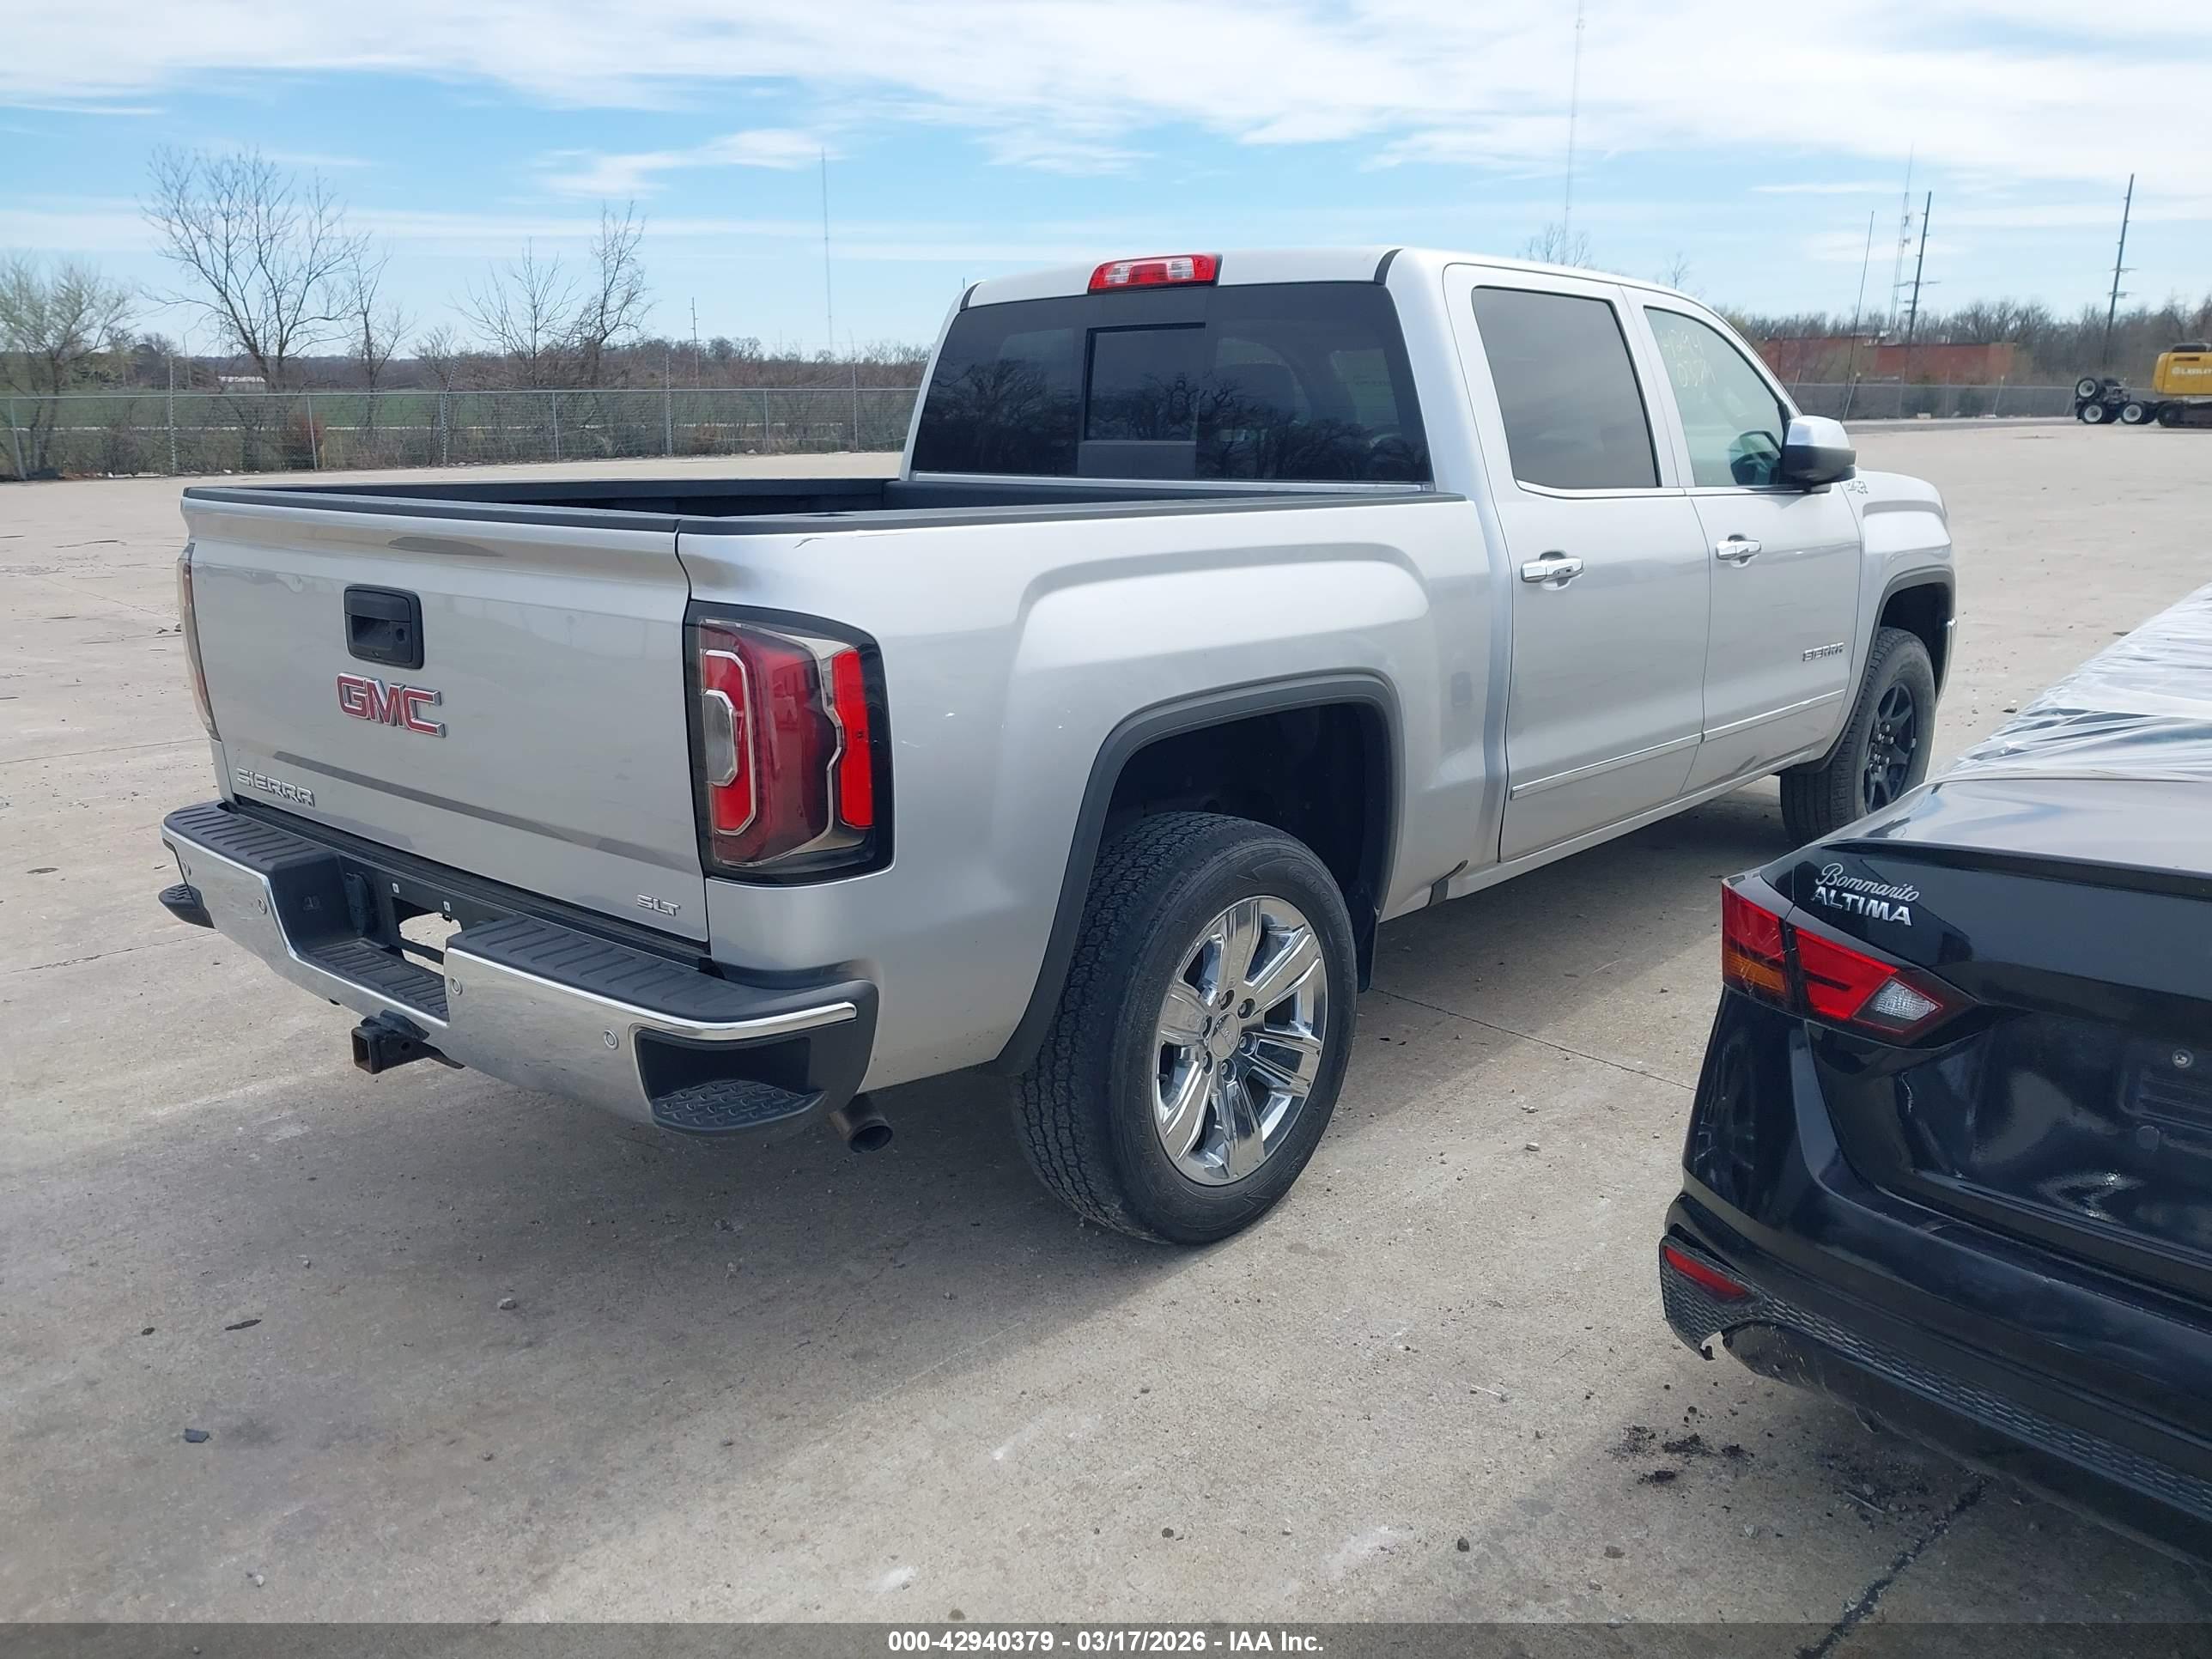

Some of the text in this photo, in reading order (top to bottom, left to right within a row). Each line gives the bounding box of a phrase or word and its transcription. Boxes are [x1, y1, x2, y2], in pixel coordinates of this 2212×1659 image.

[337, 672, 447, 738] GMC
[236, 767, 315, 807] SIERRA
[1814, 862, 1920, 902] Bommarito
[637, 893, 681, 916] SLT
[1810, 885, 1912, 926] ALTIMA
